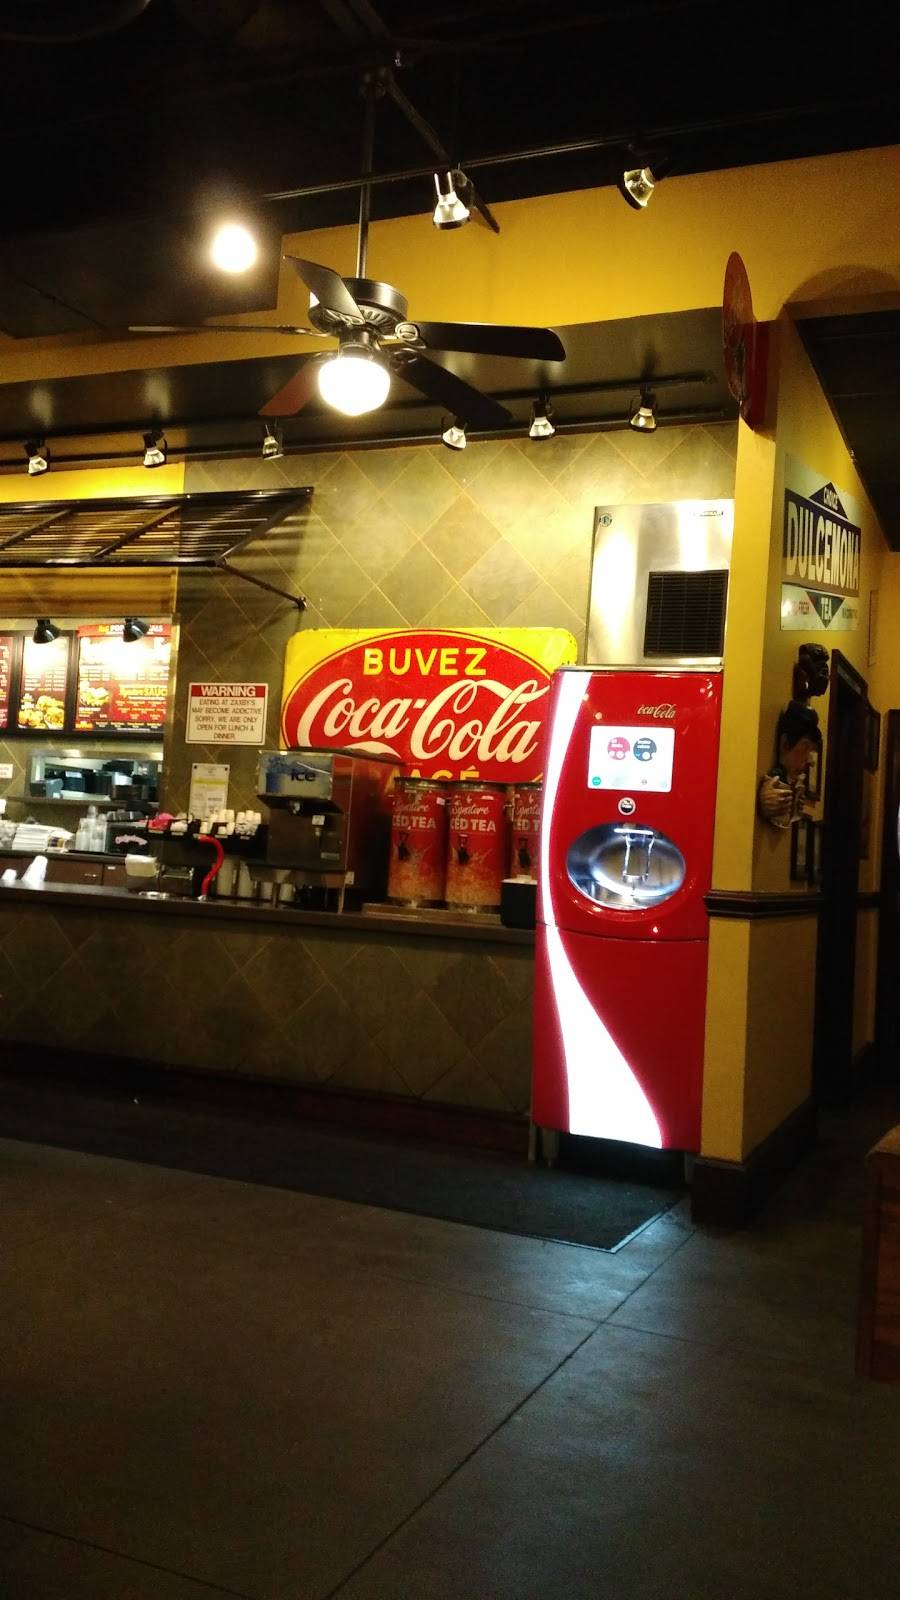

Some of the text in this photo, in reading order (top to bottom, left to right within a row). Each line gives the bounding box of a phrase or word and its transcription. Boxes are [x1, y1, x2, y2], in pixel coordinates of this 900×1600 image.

[786, 501, 859, 590] DULCEMONA
[363, 647, 487, 676] BUVEZ
[200, 685, 256, 697] WARNING
[297, 677, 550, 764] Coca-Cola
[290, 768, 316, 782] ice
[451, 803, 490, 817] Signature
[391, 814, 437, 829] CED TEA
[449, 817, 497, 832] CED TEA
